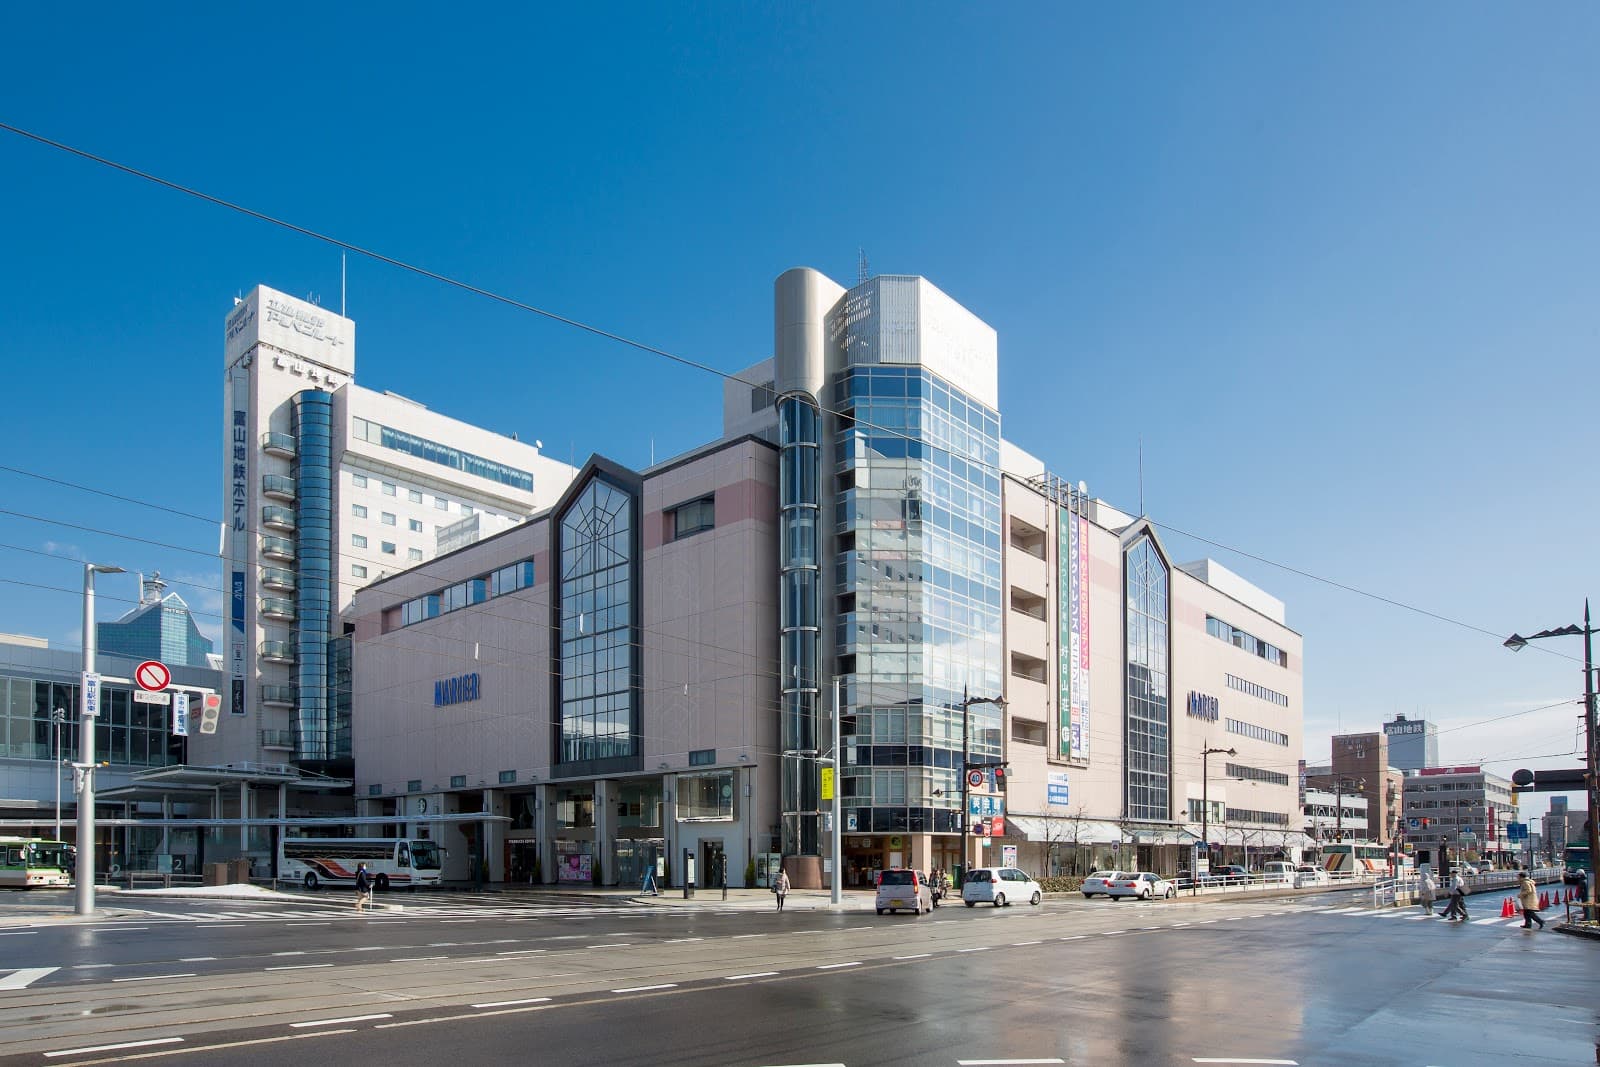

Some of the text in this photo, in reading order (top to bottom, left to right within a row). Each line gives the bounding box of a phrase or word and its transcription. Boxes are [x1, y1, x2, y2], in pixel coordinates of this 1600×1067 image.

[233, 410, 246, 532] 富山地鉄ホテル
[1070, 519, 1080, 631] コンタクトレンズ
[1385, 724, 1423, 736] 富山地鉄
[972, 774, 980, 783] 40
[174, 859, 183, 870] 2
